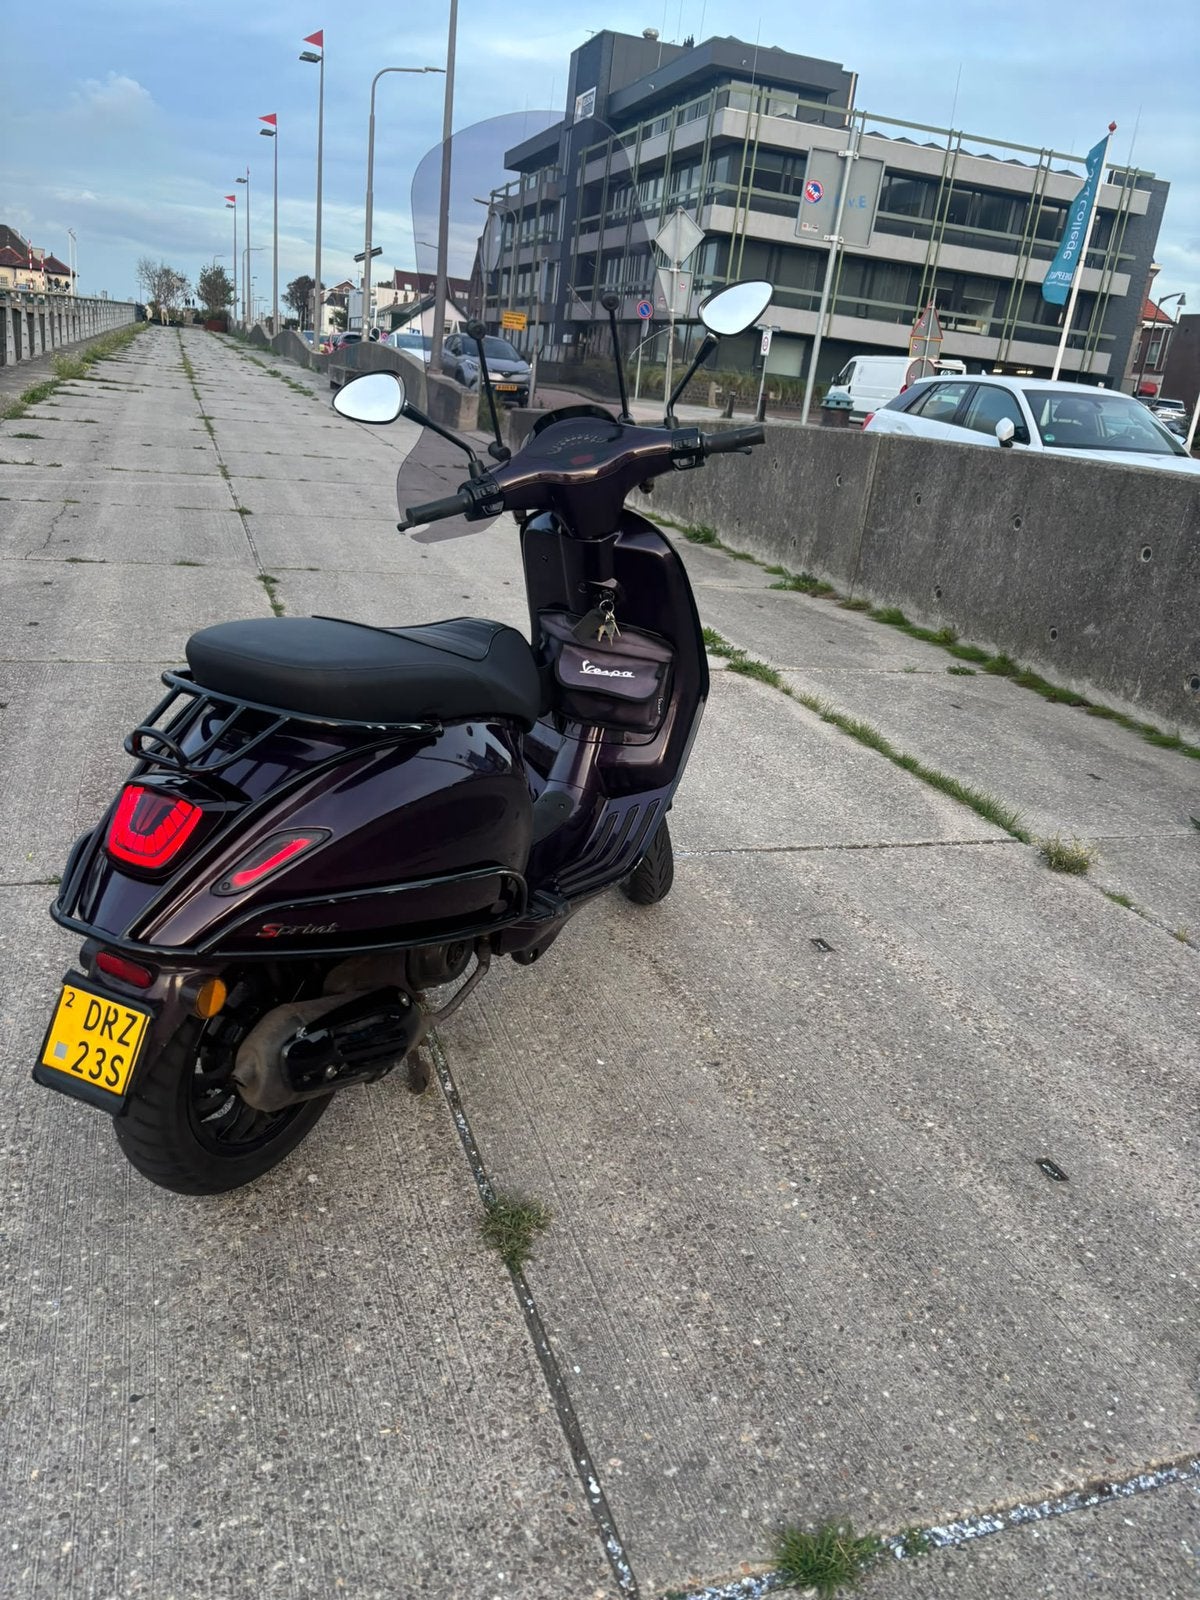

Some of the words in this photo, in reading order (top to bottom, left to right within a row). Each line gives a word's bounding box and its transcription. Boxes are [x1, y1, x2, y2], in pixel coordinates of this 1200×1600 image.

[579, 660, 635, 678] Vespa
[256, 922, 339, 938] Sprint
[65, 992, 75, 1008] 2
[83, 999, 138, 1047] DRZ
[71, 1041, 125, 1087] 23S
